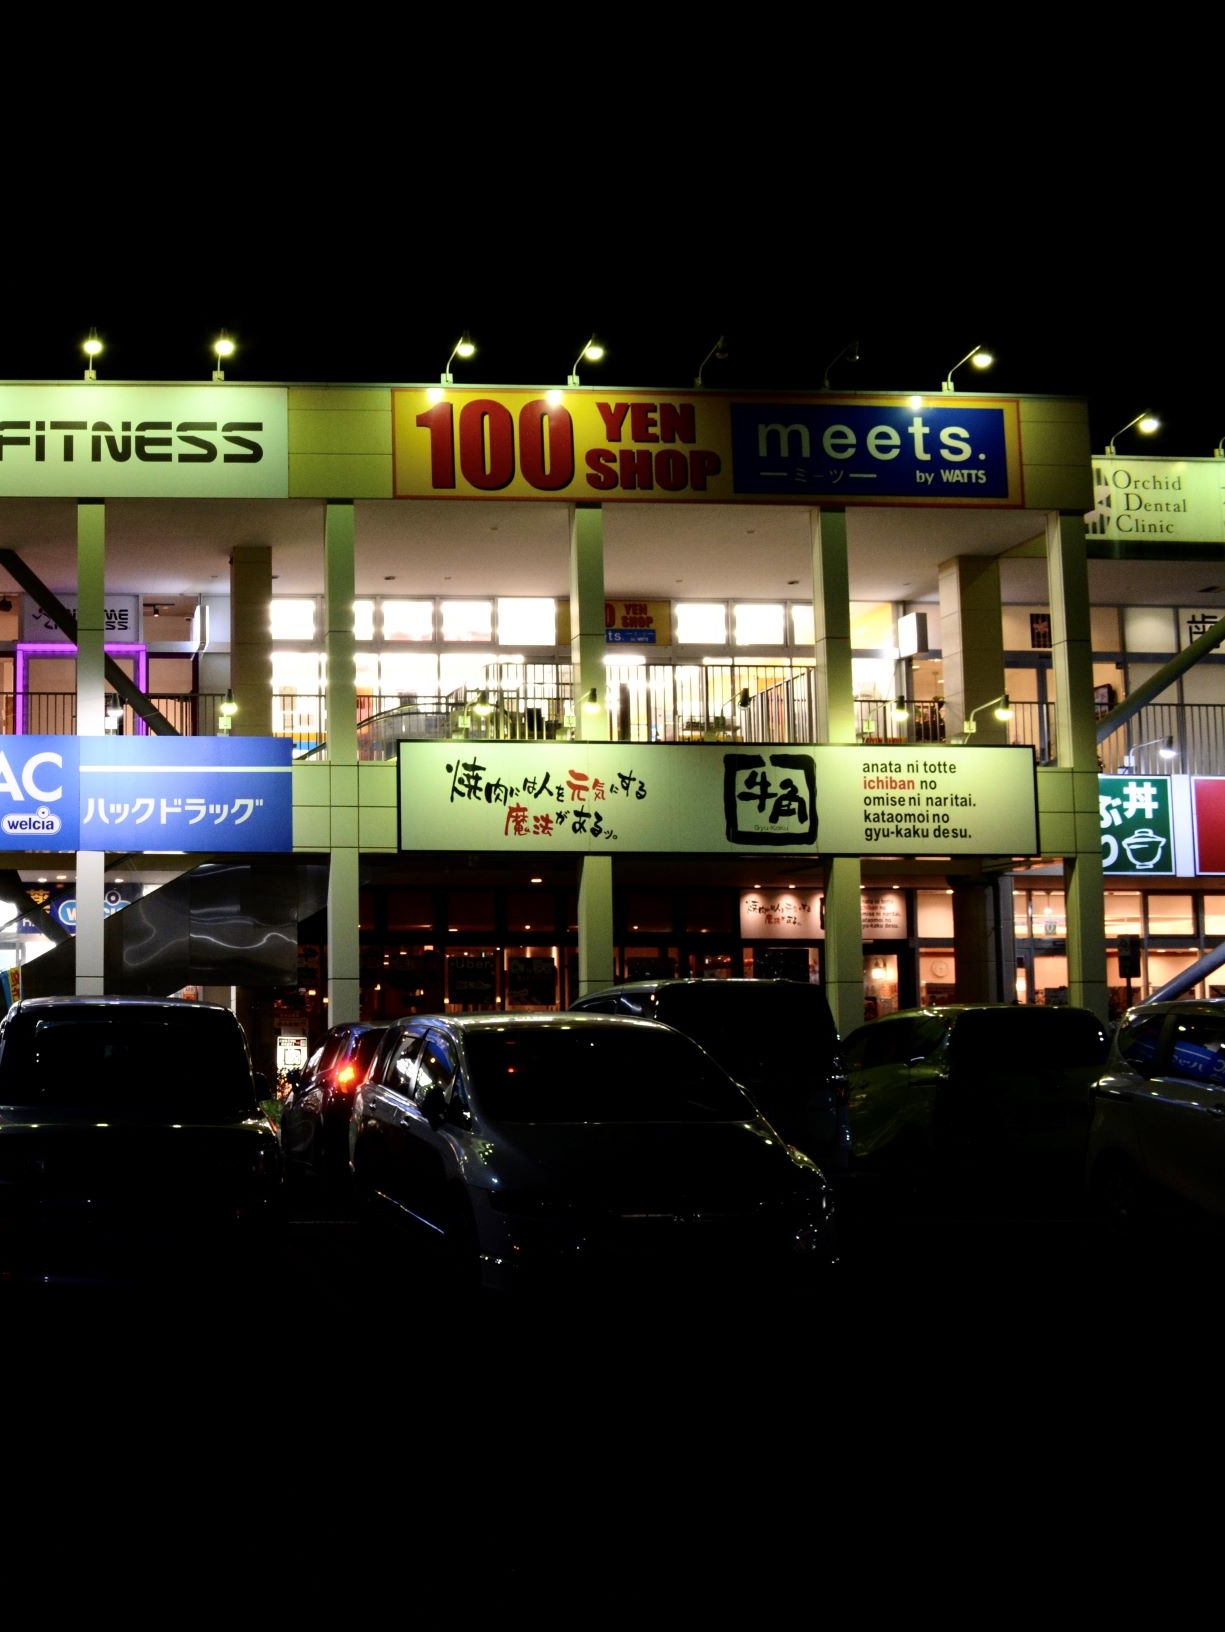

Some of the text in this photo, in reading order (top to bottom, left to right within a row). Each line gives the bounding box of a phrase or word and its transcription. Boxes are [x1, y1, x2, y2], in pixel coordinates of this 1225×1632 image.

[596, 402, 696, 444] YEN
[416, 399, 575, 491] 100
[757, 416, 986, 462] meets.
[585, 448, 722, 491] SHOP
[916, 469, 986, 485] by WATTS
[1112, 469, 1182, 491] Orchid
[1123, 493, 1188, 512] Dental
[1116, 514, 1175, 534] Clinic
[862, 760, 957, 774] anata ni totte
[445, 757, 647, 806] 焼肉には人を元気にする
[863, 776, 937, 790] ichiban no
[737, 770, 809, 824] 牛角
[864, 793, 976, 807] omise ni naritai.
[83, 797, 264, 825] ハックドラッグ
[864, 809, 950, 823] kataomoi no
[7, 817, 55, 831] welcia
[864, 825, 972, 841] gyu-kaku desu.
